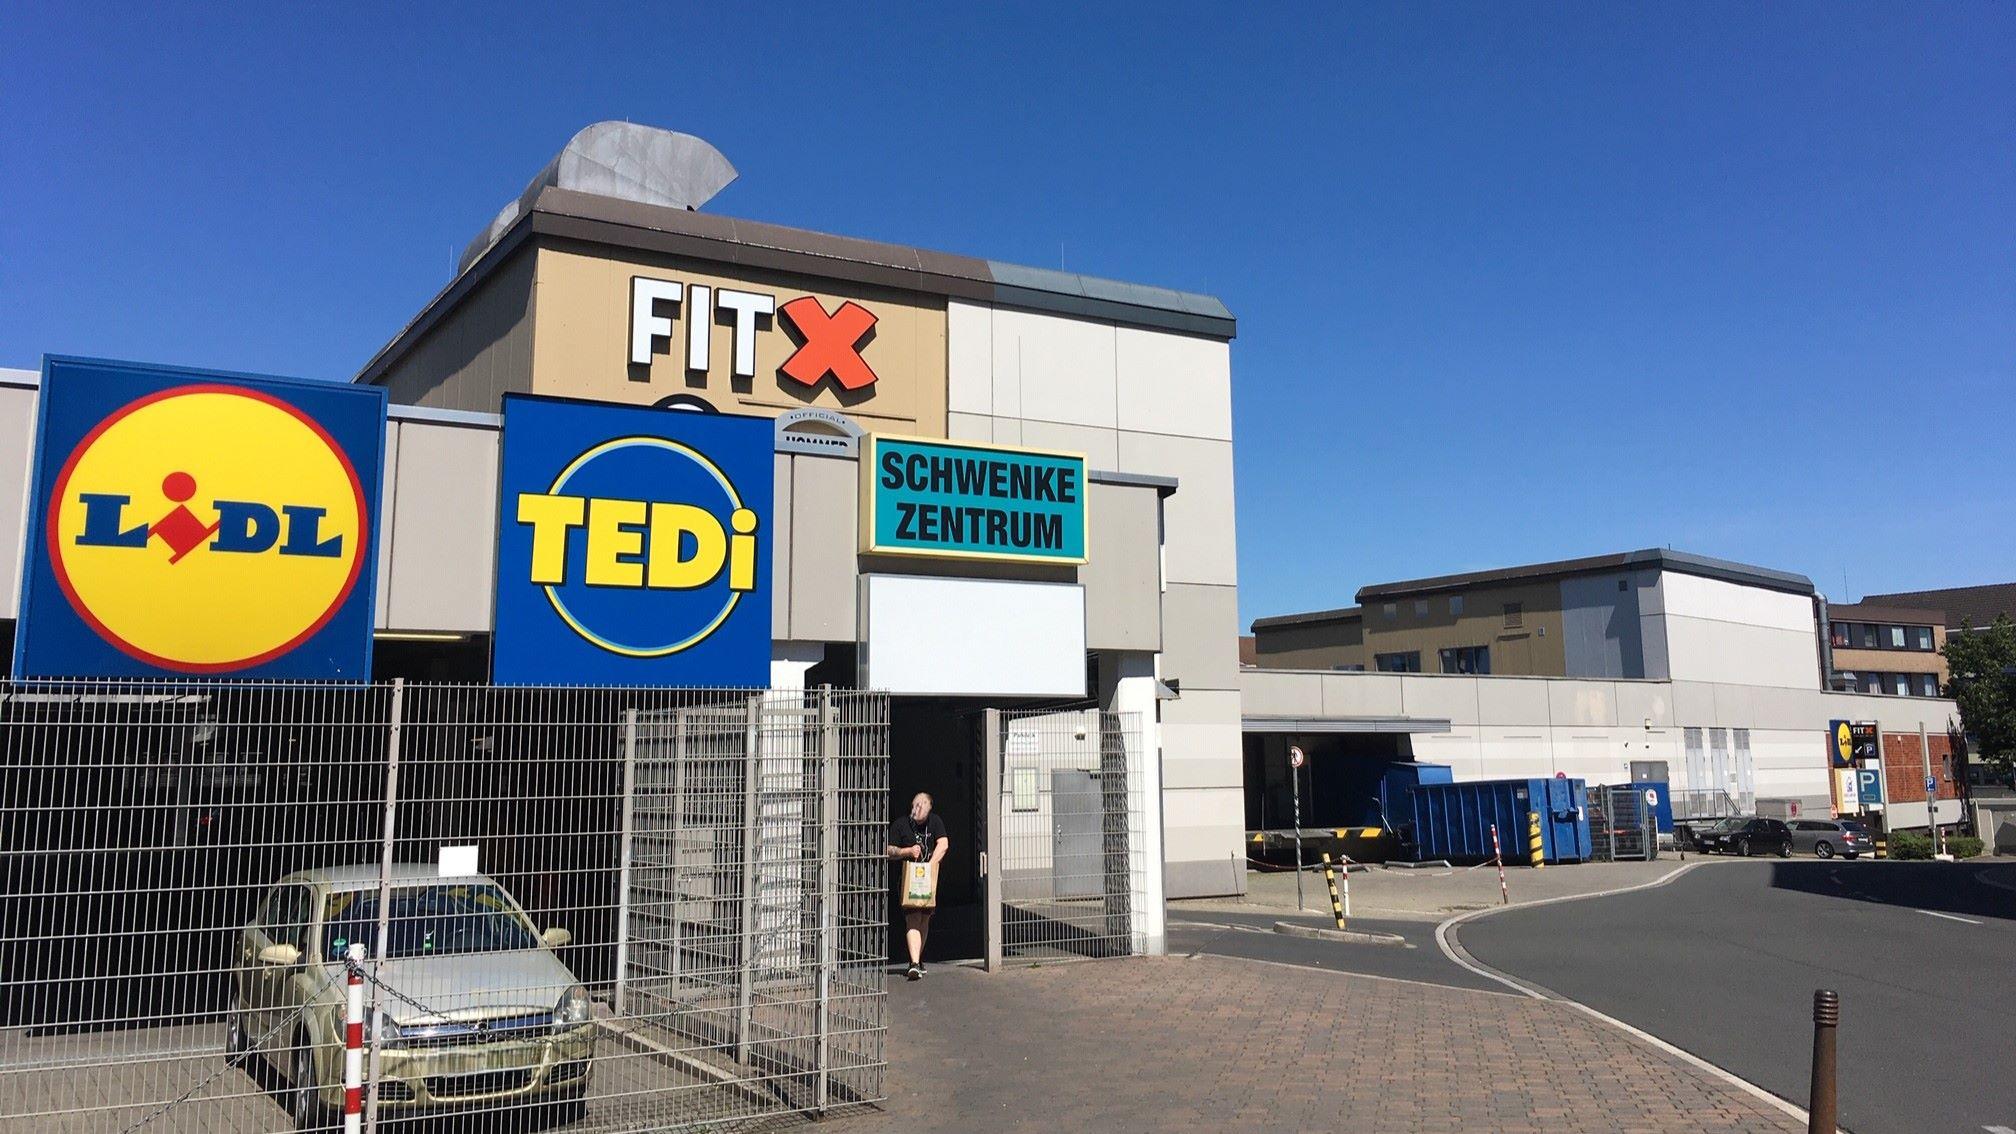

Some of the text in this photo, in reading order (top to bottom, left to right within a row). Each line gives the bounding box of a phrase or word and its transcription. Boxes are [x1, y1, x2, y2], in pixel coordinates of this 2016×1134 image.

[630, 276, 879, 392] FITX
[794, 412, 841, 424] OFFICIAL
[881, 451, 1075, 504] SCHWENKE
[517, 493, 758, 591] TEDi
[895, 502, 1063, 550] ZENTRUM
[1860, 772, 1875, 792] P
